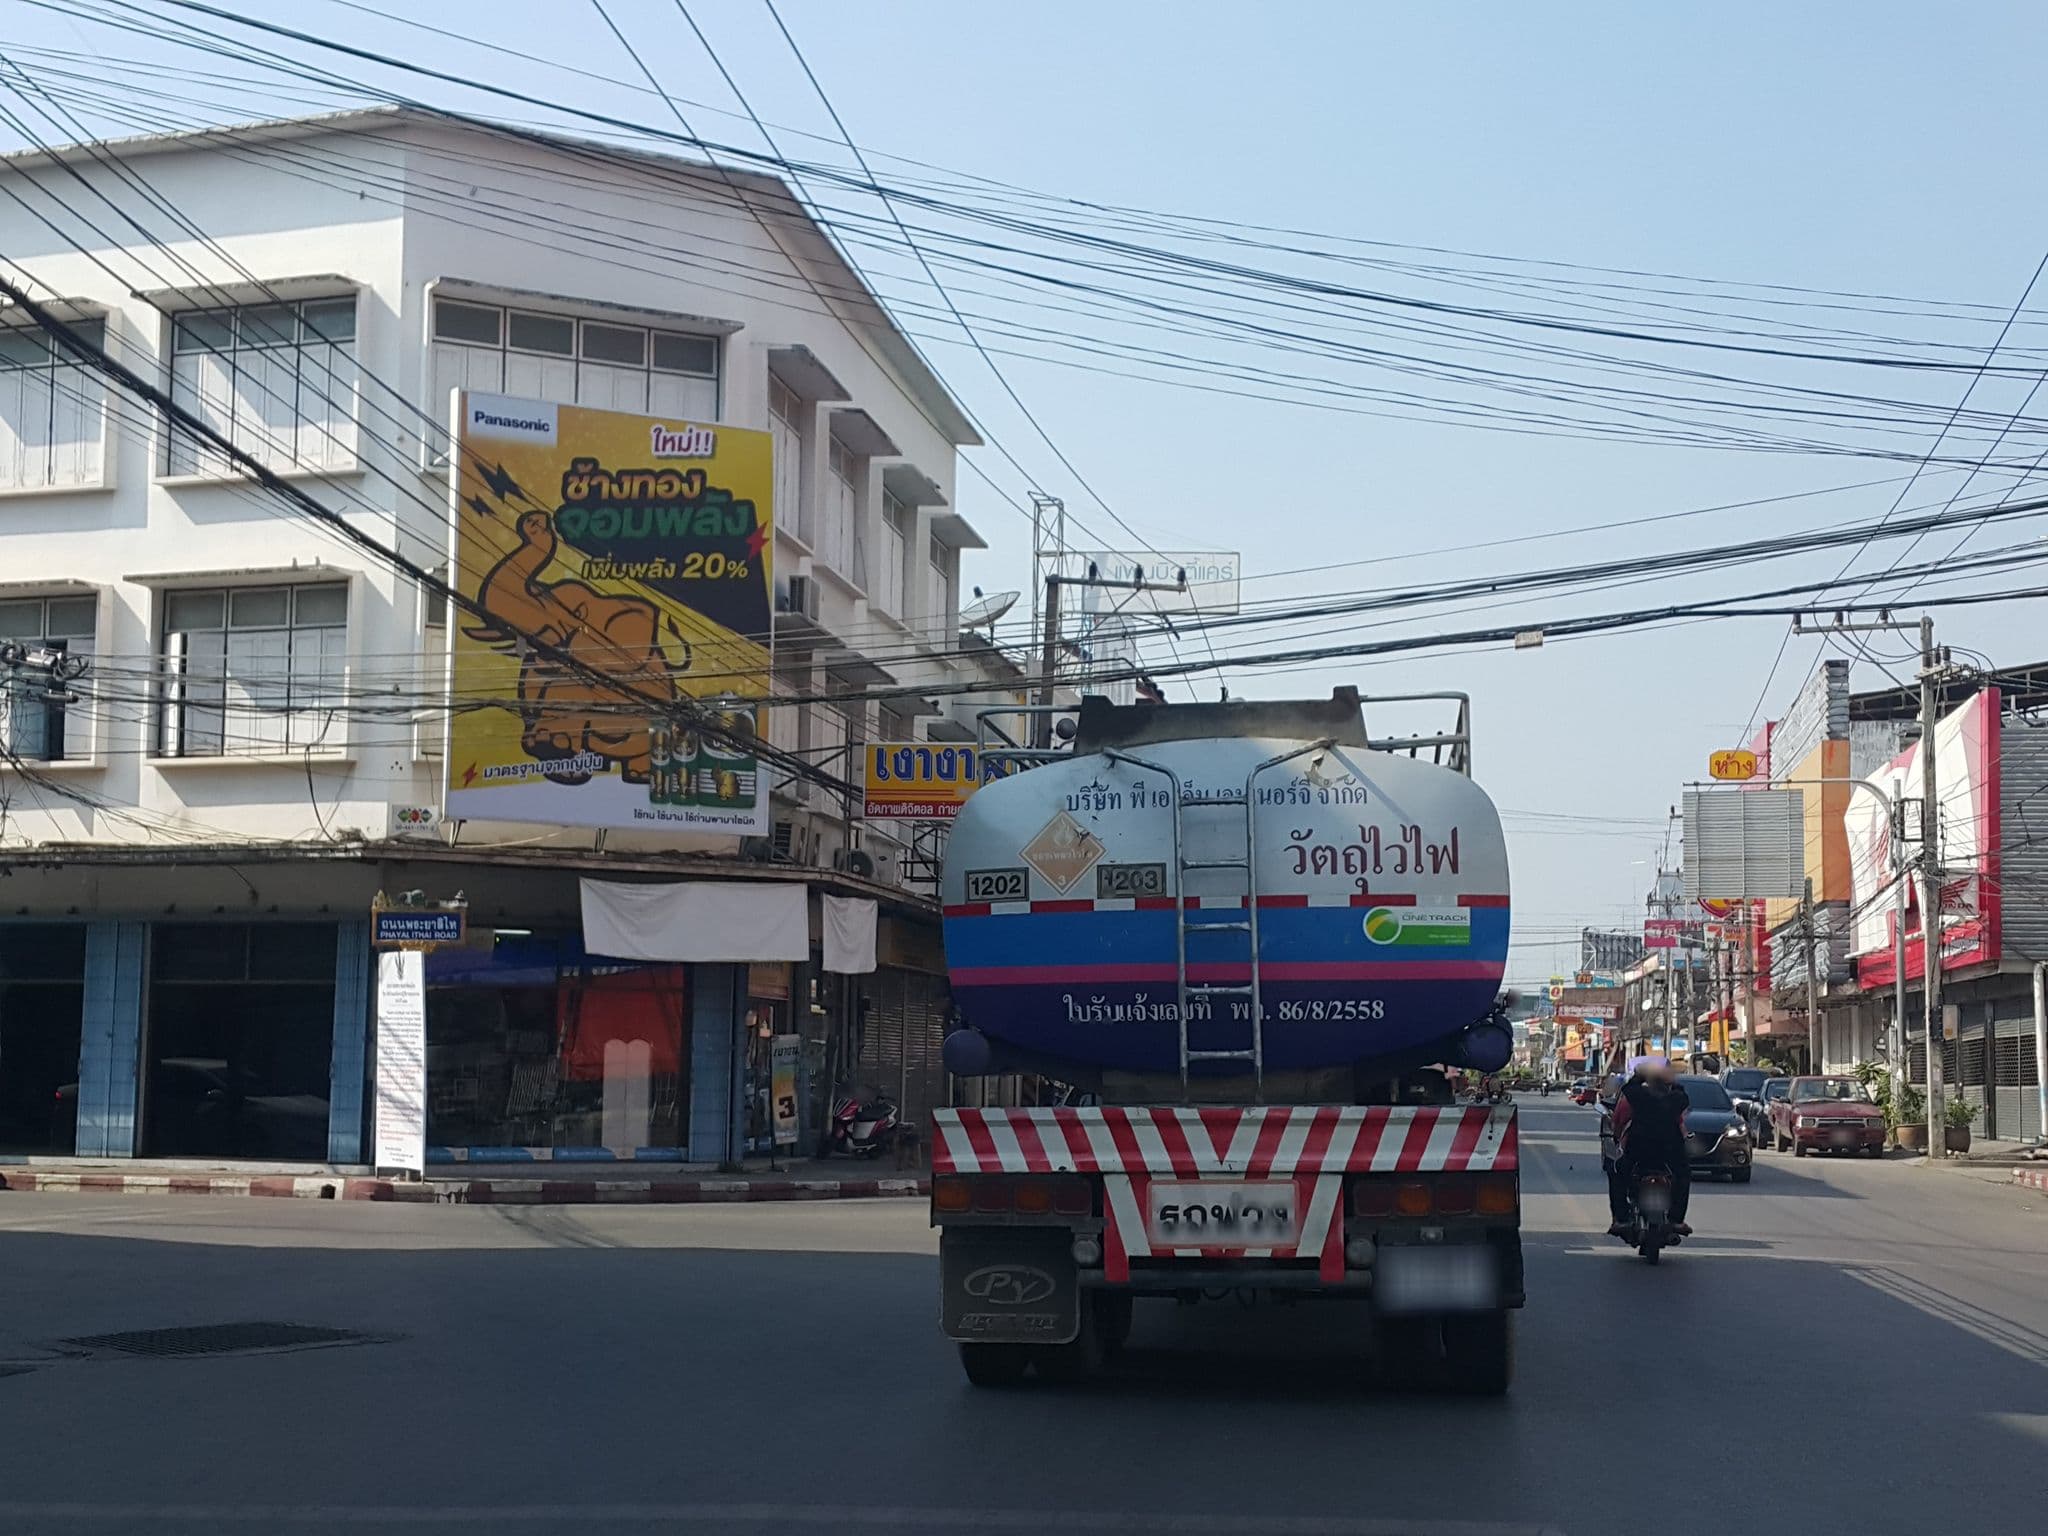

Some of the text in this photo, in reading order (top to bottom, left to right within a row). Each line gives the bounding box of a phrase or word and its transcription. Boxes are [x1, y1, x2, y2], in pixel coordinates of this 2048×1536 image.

[473, 410, 551, 433] Panasonic
[652, 425, 712, 454] ใหม่!!
[565, 461, 704, 501] ช้างทอง
[559, 494, 752, 540] จอมพลัง
[582, 551, 749, 580] เพิ่มพลัง 20%
[483, 749, 604, 778] มาตรฐานจากญี่ปุ่น
[1066, 782, 1121, 812] บริษัท
[1283, 823, 1460, 896] วัตถุไวไฟ
[970, 874, 1022, 896] 1202
[1057, 874, 1067, 886] 3
[1103, 869, 1159, 891] 1203
[434, 930, 458, 939] ROAD
[1278, 999, 1385, 1021] 86/8/2558
